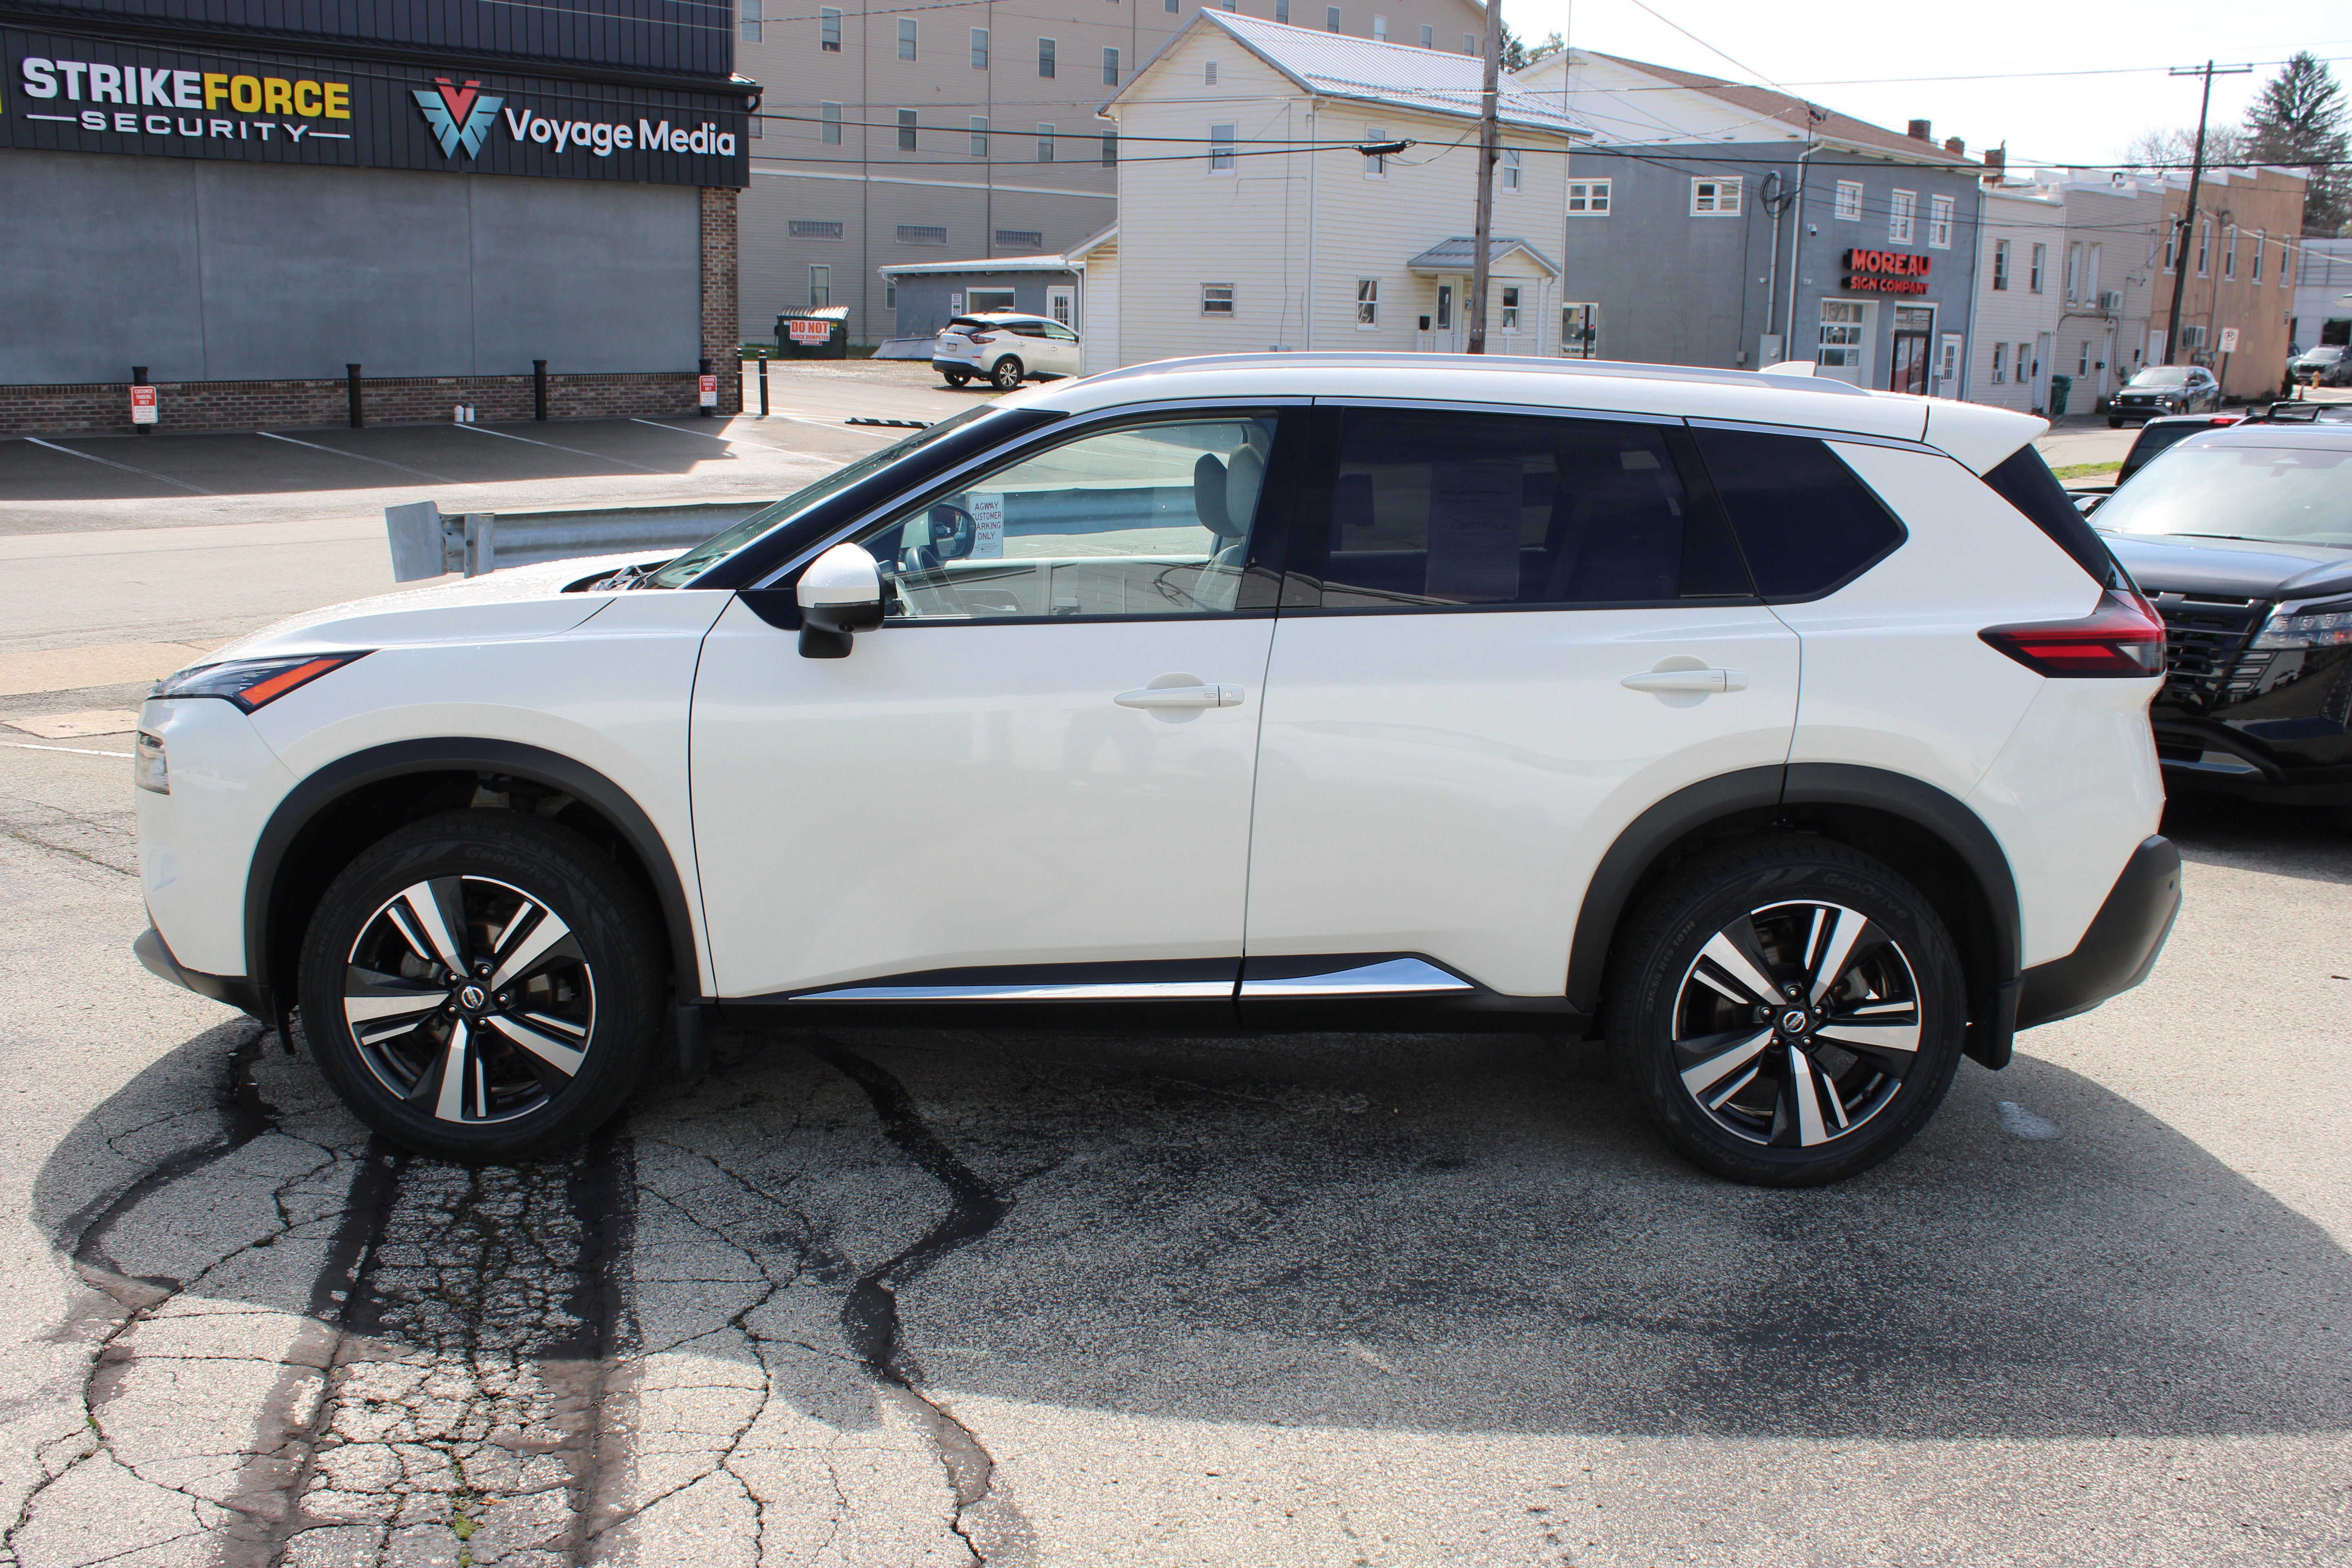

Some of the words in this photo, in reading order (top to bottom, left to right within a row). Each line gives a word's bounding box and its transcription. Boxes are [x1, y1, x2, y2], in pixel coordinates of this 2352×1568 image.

[22, 57, 351, 119] STRIKEFORCE
[81, 111, 309, 143] SECURITY
[504, 107, 633, 157] Voyage
[639, 118, 736, 156] Media
[1851, 248, 1932, 276] MOREAU
[1850, 276, 1878, 290] SIGN
[1880, 278, 1930, 295] COMPANY
[792, 321, 805, 333] DO
[808, 322, 829, 334] NOT
[974, 501, 999, 510] AGWAY
[976, 521, 1001, 530] ARKING
[978, 532, 996, 540] ONLY
[1822, 873, 1908, 919] GeoDrive
[1646, 971, 1662, 1013] 235/55
[1659, 947, 1674, 971] R19
[1673, 920, 1695, 947] 101H
